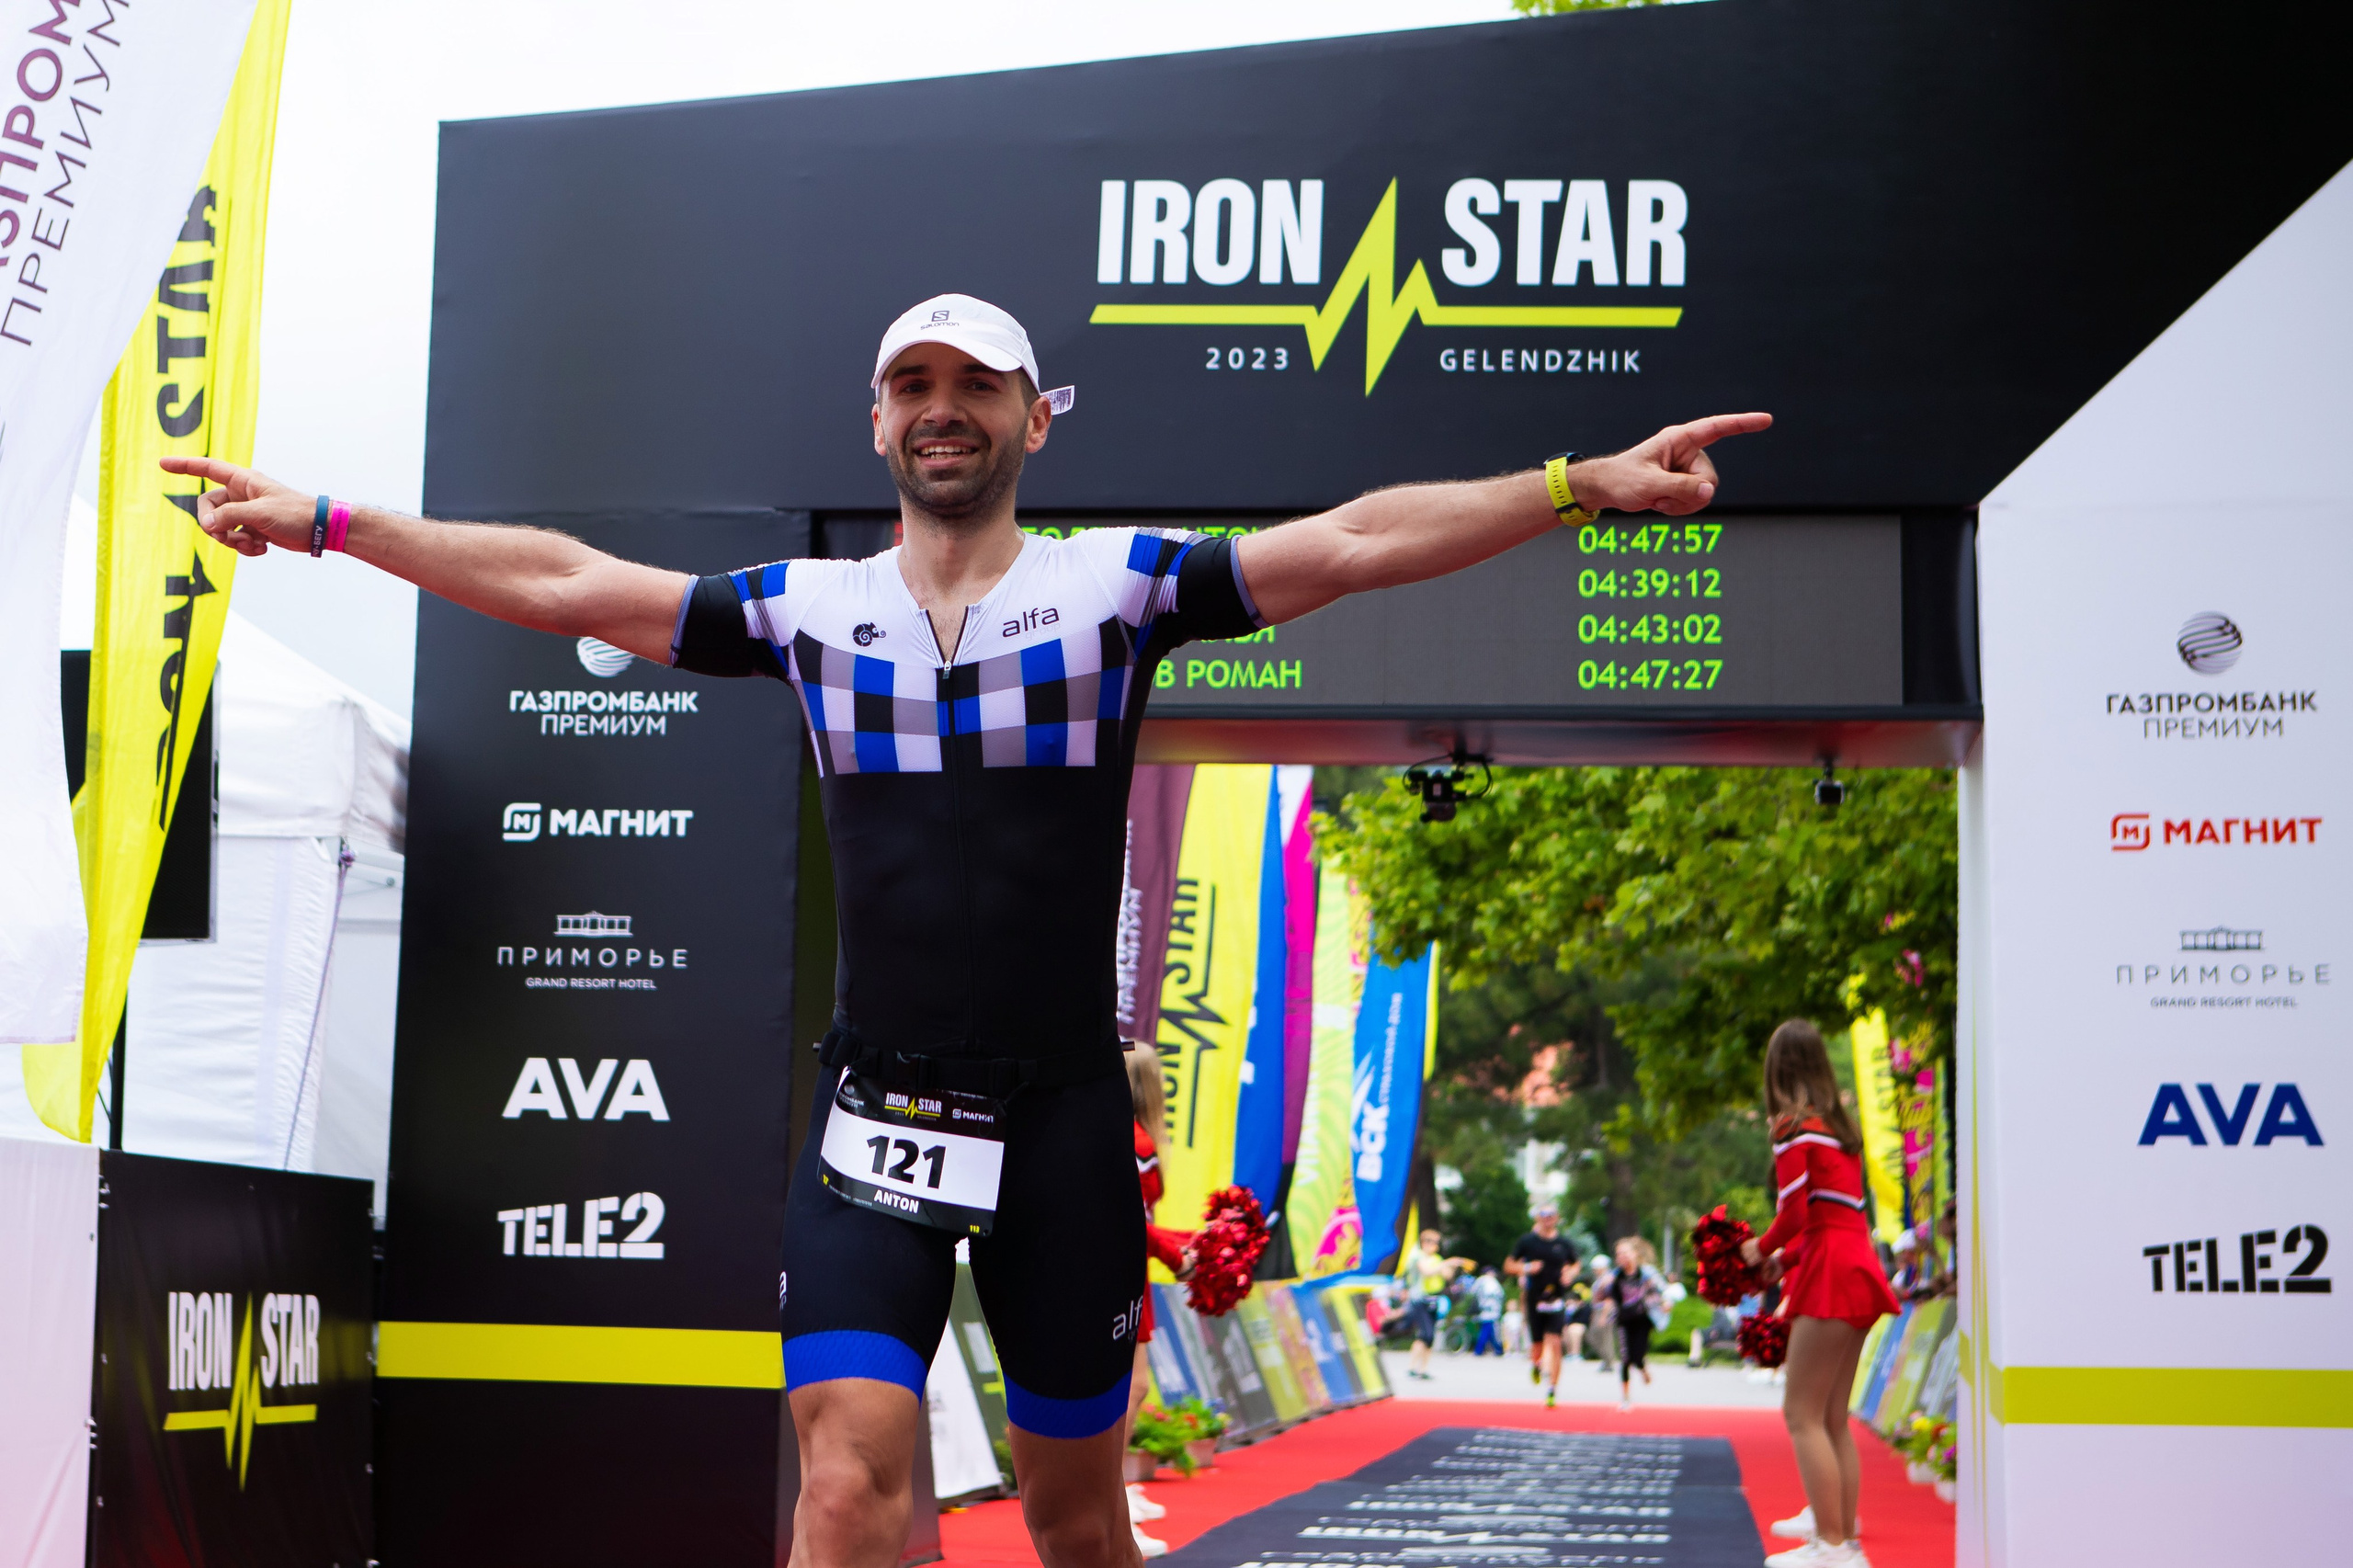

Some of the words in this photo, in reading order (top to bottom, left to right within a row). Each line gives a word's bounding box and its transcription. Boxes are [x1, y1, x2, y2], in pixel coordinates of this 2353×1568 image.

[1097, 178, 1324, 285] IRON
[1441, 177, 1688, 287] STAR
[1205, 347, 1290, 370] 2023
[1439, 349, 1641, 373] GELENDZHIK
[1577, 524, 1723, 554] 04:47:57
[1577, 568, 1723, 598] 04:39:12
[1002, 608, 1060, 638] alfa
[1577, 613, 1723, 644] 04:43:02
[1186, 658, 1303, 689] РОМАН
[1577, 659, 1723, 690] 04:47:27
[508, 690, 699, 713] ГАЗПРОМБАНК
[2106, 690, 2318, 715] ГАЗПРОМБАНК
[540, 713, 667, 736] ПРЕМИУМ
[2143, 716, 2284, 739] ПРЕМИУМ
[550, 809, 694, 837] МАГНИТ
[2163, 816, 2324, 845] МАГНИТ
[496, 947, 688, 969] ПРИМОРЬЕ
[525, 977, 568, 990] GRAND
[570, 977, 616, 990] RESORT
[618, 978, 657, 991] HOTEL
[2116, 963, 2332, 985] ПРИМОРЬЕ
[2150, 996, 2197, 1009] GRAND
[2200, 996, 2253, 1009] RESORT
[2255, 996, 2299, 1009] HOTEL
[502, 1057, 670, 1121] AVA
[885, 1092, 909, 1108] IRON
[917, 1097, 942, 1114] STAR
[2137, 1083, 2325, 1146] AVA
[1356, 1101, 1390, 1183] ВСК
[866, 1135, 947, 1189] 121
[874, 1189, 919, 1214] ANTON
[497, 1192, 666, 1259] TELE2
[2143, 1223, 2333, 1294] TELE2
[1113, 1295, 1143, 1340] alf
[168, 1291, 233, 1391] IRON
[260, 1292, 320, 1389] STAR
